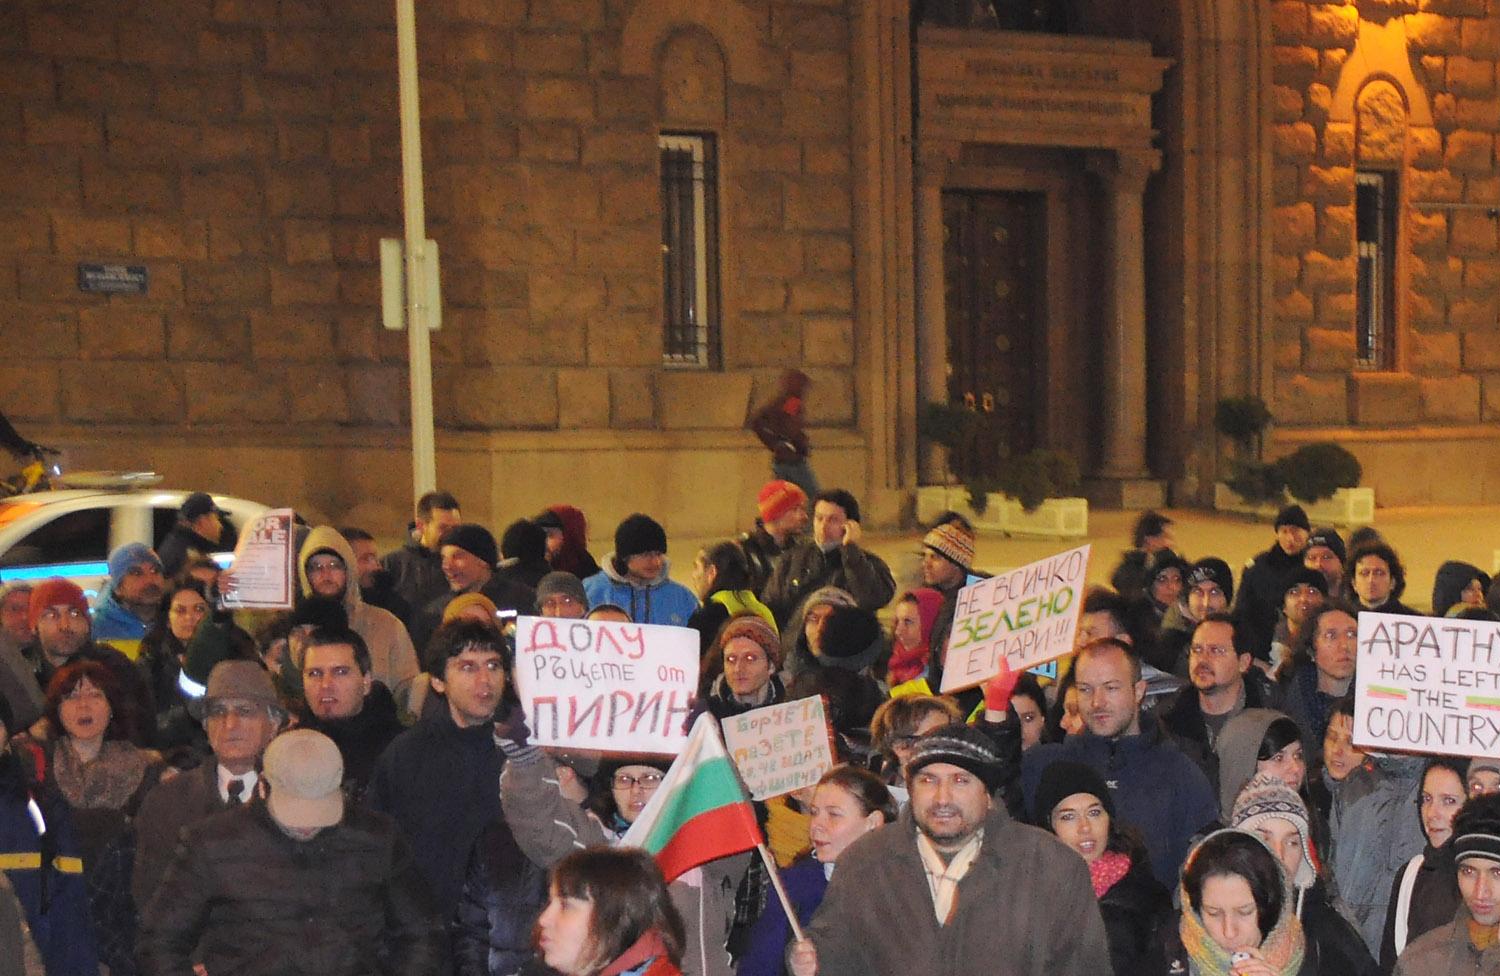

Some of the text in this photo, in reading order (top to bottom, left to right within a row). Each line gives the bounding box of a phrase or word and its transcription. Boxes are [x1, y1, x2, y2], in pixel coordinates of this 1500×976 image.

[957, 551, 1082, 617] НЕ ВСИЧКО
[953, 586, 1073, 648] ЗЕЛЕНО
[524, 620, 645, 660] ДОЛУ
[966, 647, 985, 675] Е
[1377, 662, 1427, 683] HAS
[532, 689, 695, 741] ПИРИН
[1411, 688, 1459, 711] THE
